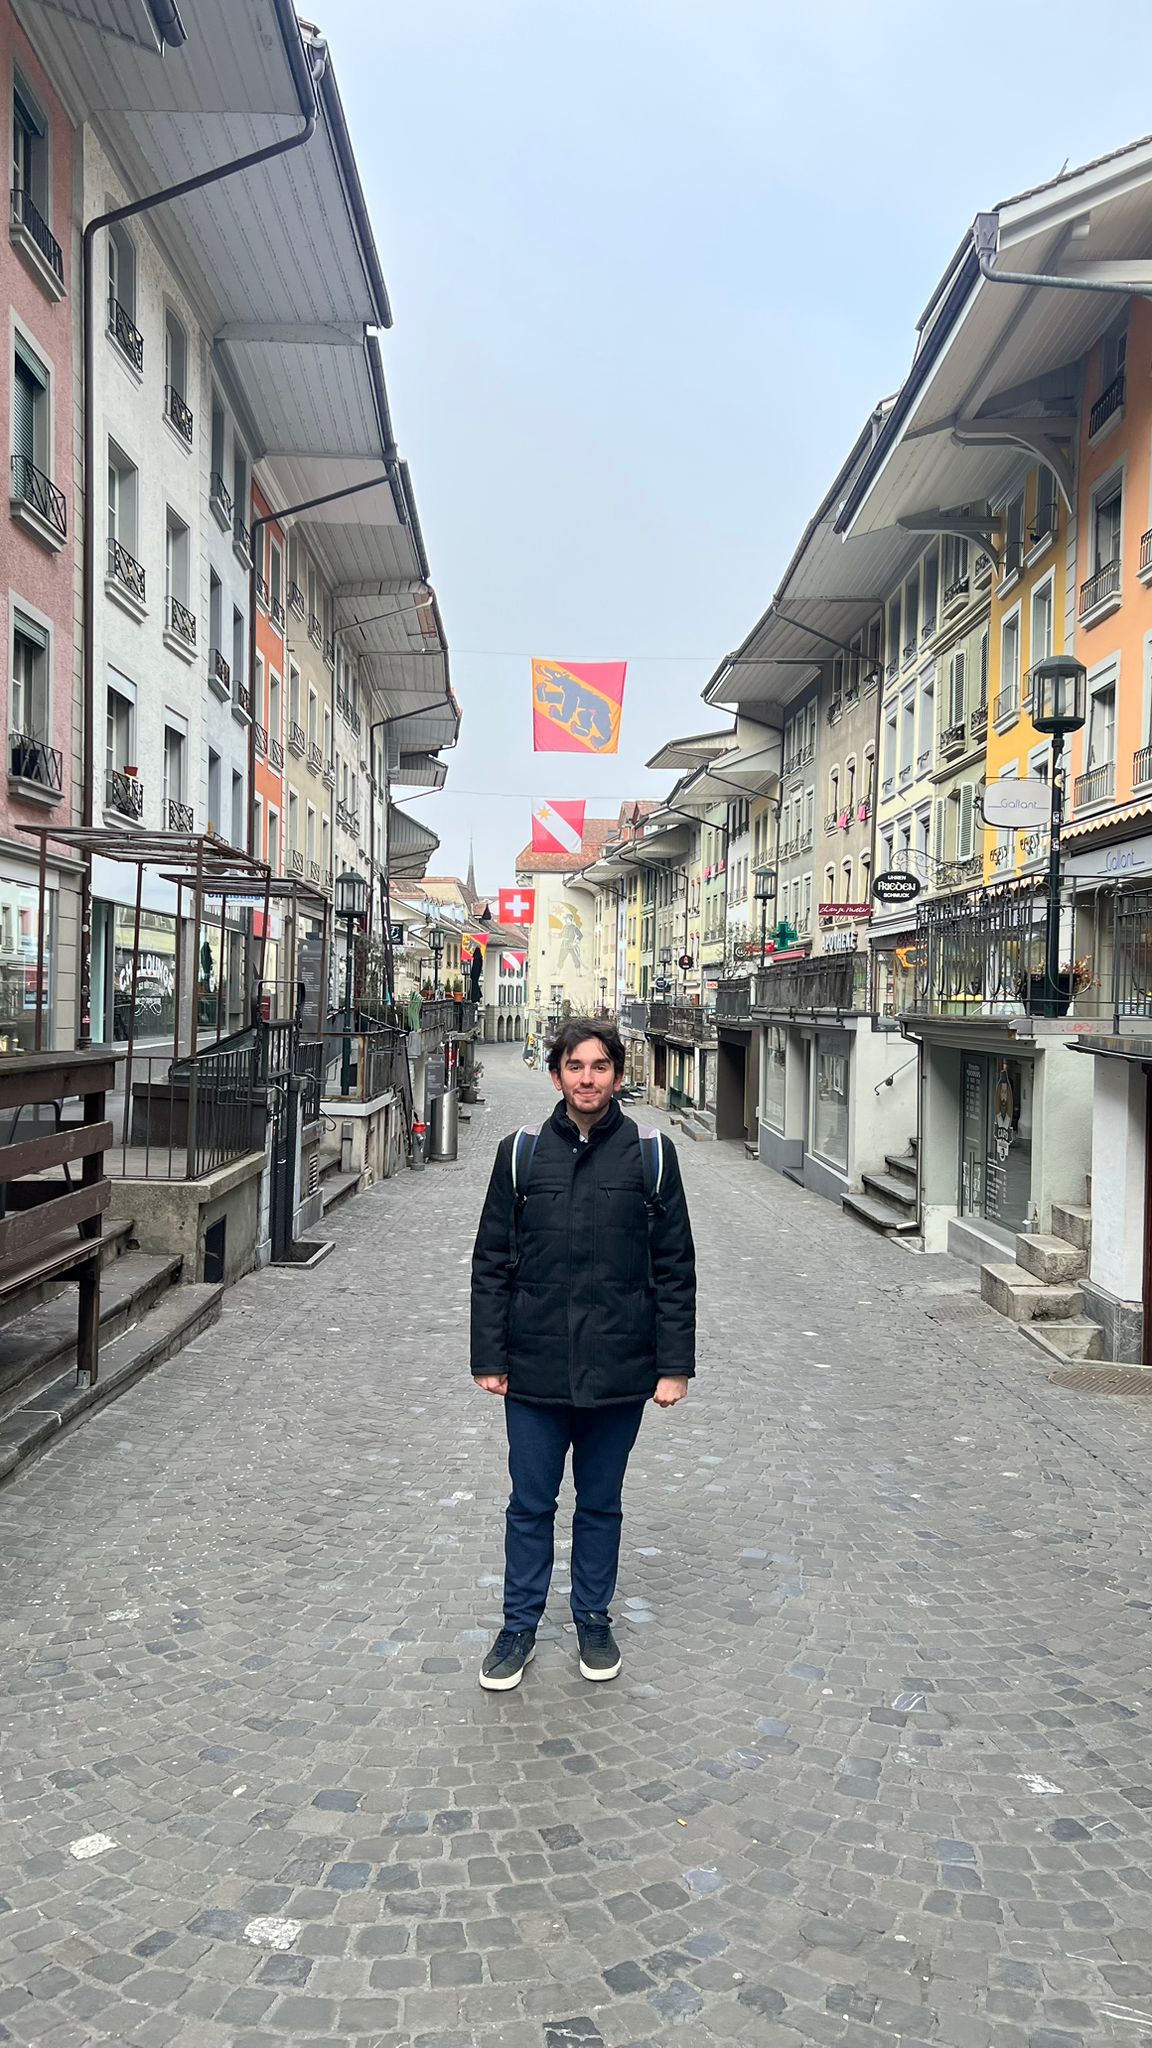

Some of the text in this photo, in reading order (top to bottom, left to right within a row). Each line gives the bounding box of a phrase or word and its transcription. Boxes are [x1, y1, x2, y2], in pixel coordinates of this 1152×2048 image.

[1001, 799, 1038, 809] Gallant
[877, 881, 916, 891] FRIEDEN
[822, 931, 858, 951] APOTHEKE
